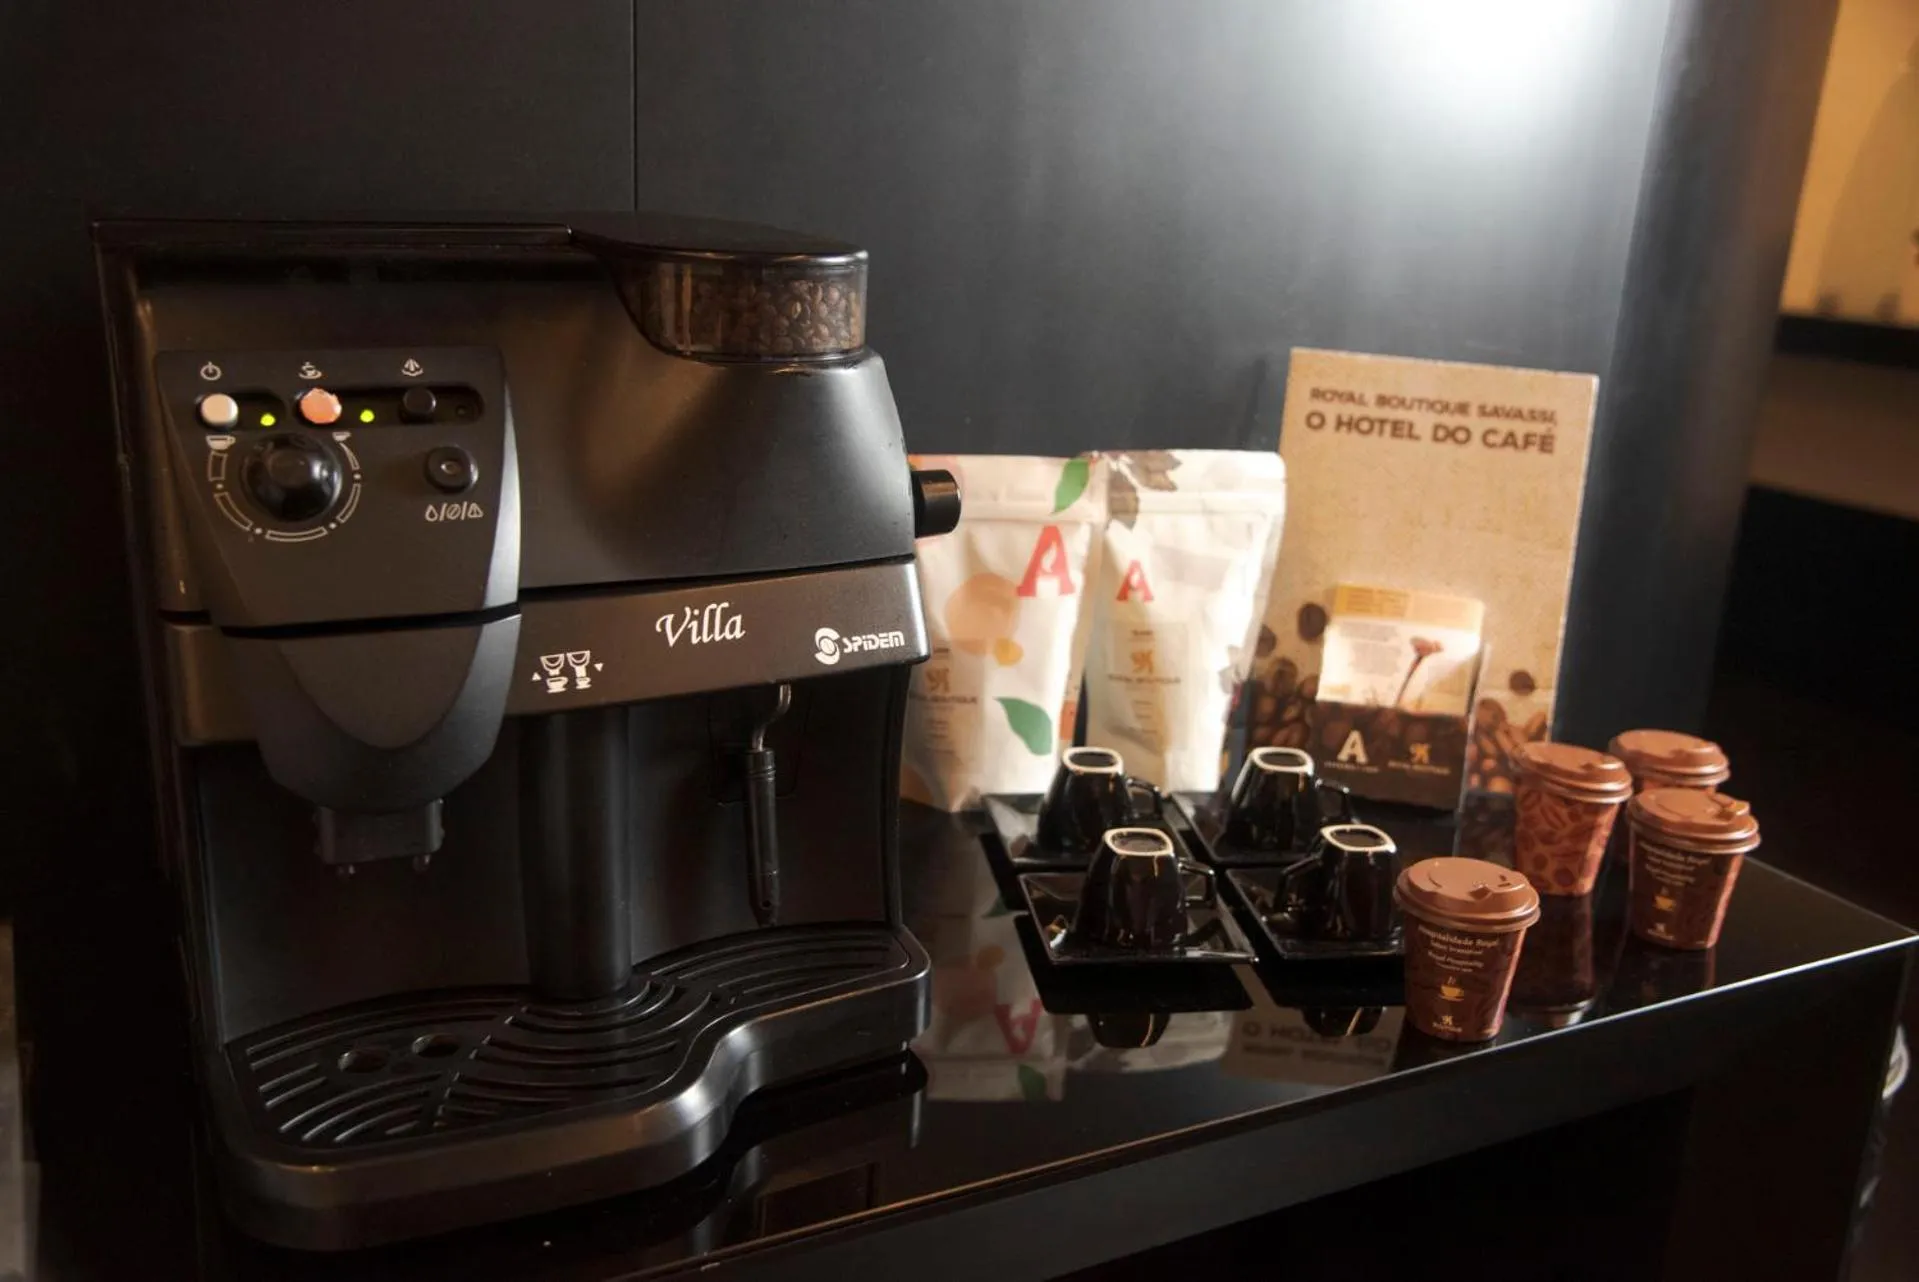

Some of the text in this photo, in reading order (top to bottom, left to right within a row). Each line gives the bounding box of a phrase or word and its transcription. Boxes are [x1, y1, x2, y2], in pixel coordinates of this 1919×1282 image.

[1309, 387, 1367, 406] ROYAL
[1374, 393, 1471, 416] BOUTIQUE
[1305, 410, 1556, 455] O HOTEL DO CAFÉ
[655, 602, 746, 648] Villa
